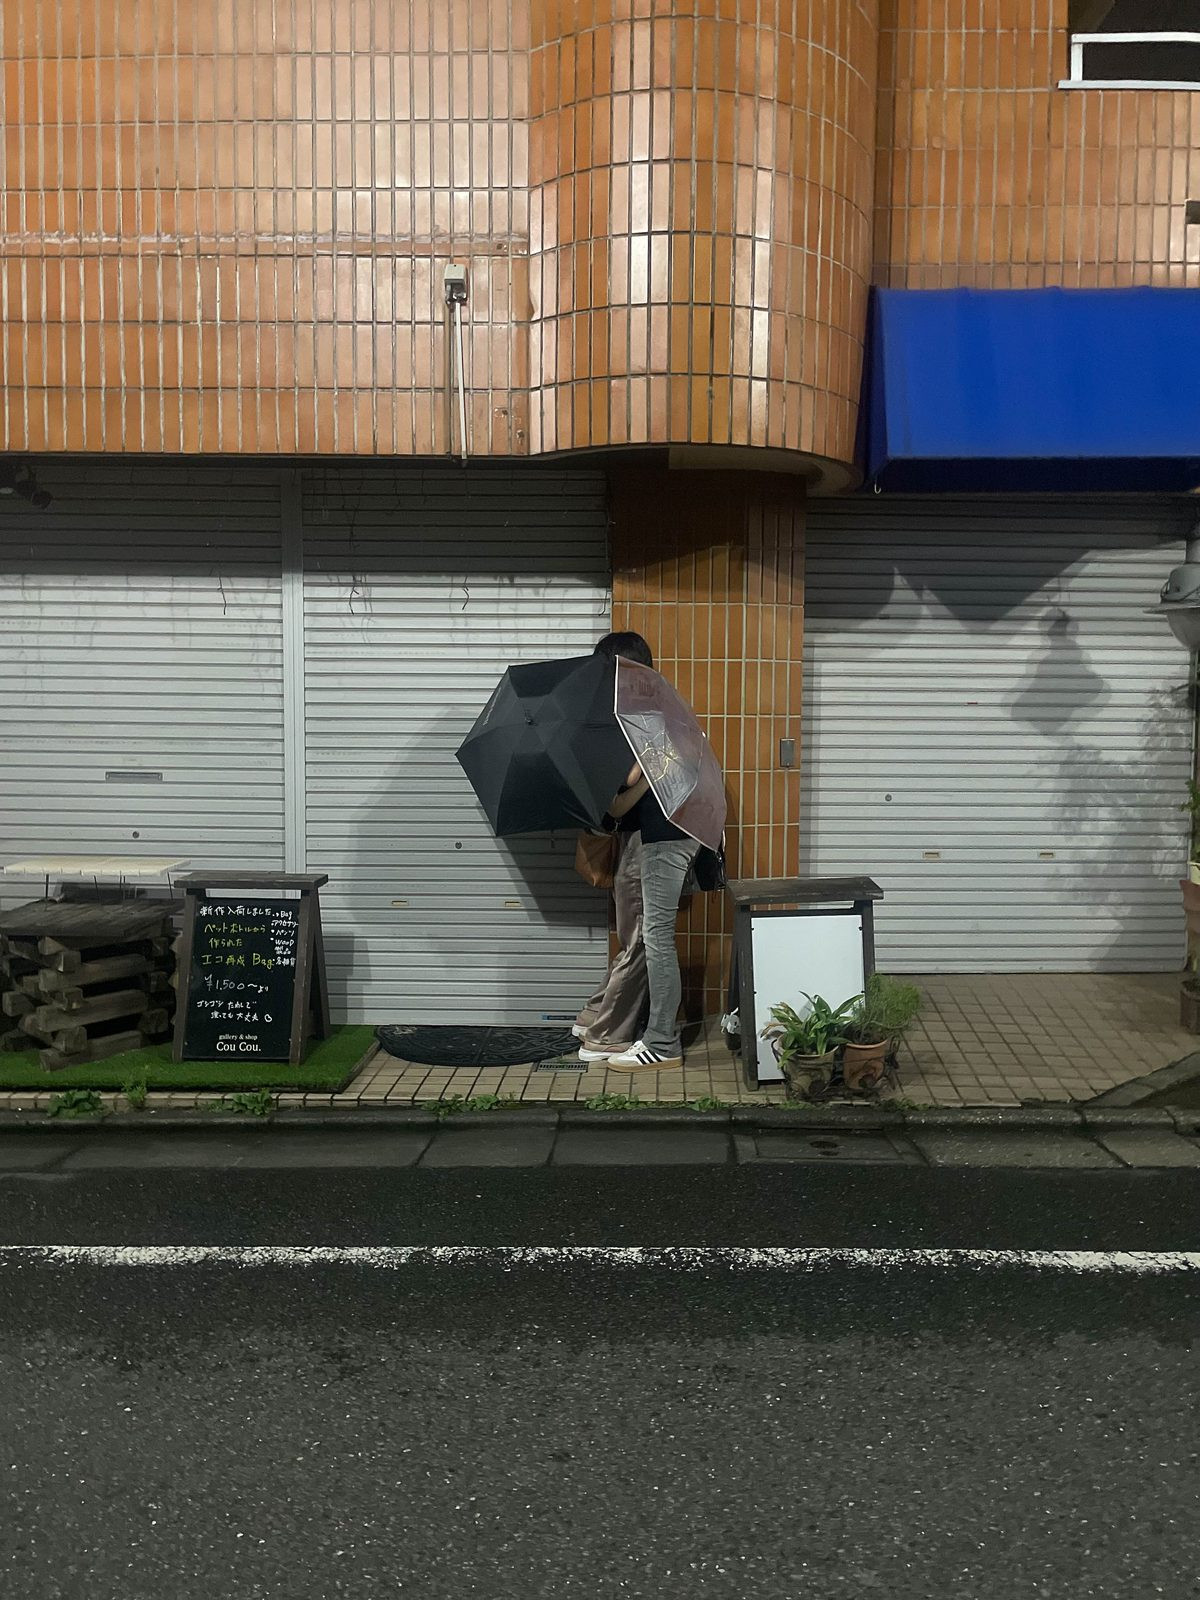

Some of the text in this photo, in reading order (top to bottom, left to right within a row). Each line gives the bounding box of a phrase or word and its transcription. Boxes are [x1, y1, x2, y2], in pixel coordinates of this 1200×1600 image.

[204, 922, 266, 934] ペットボトルから
[208, 937, 243, 949] 作られた
[252, 952, 275, 970] Bag
[216, 1041, 261, 1052] Cou Cou.
